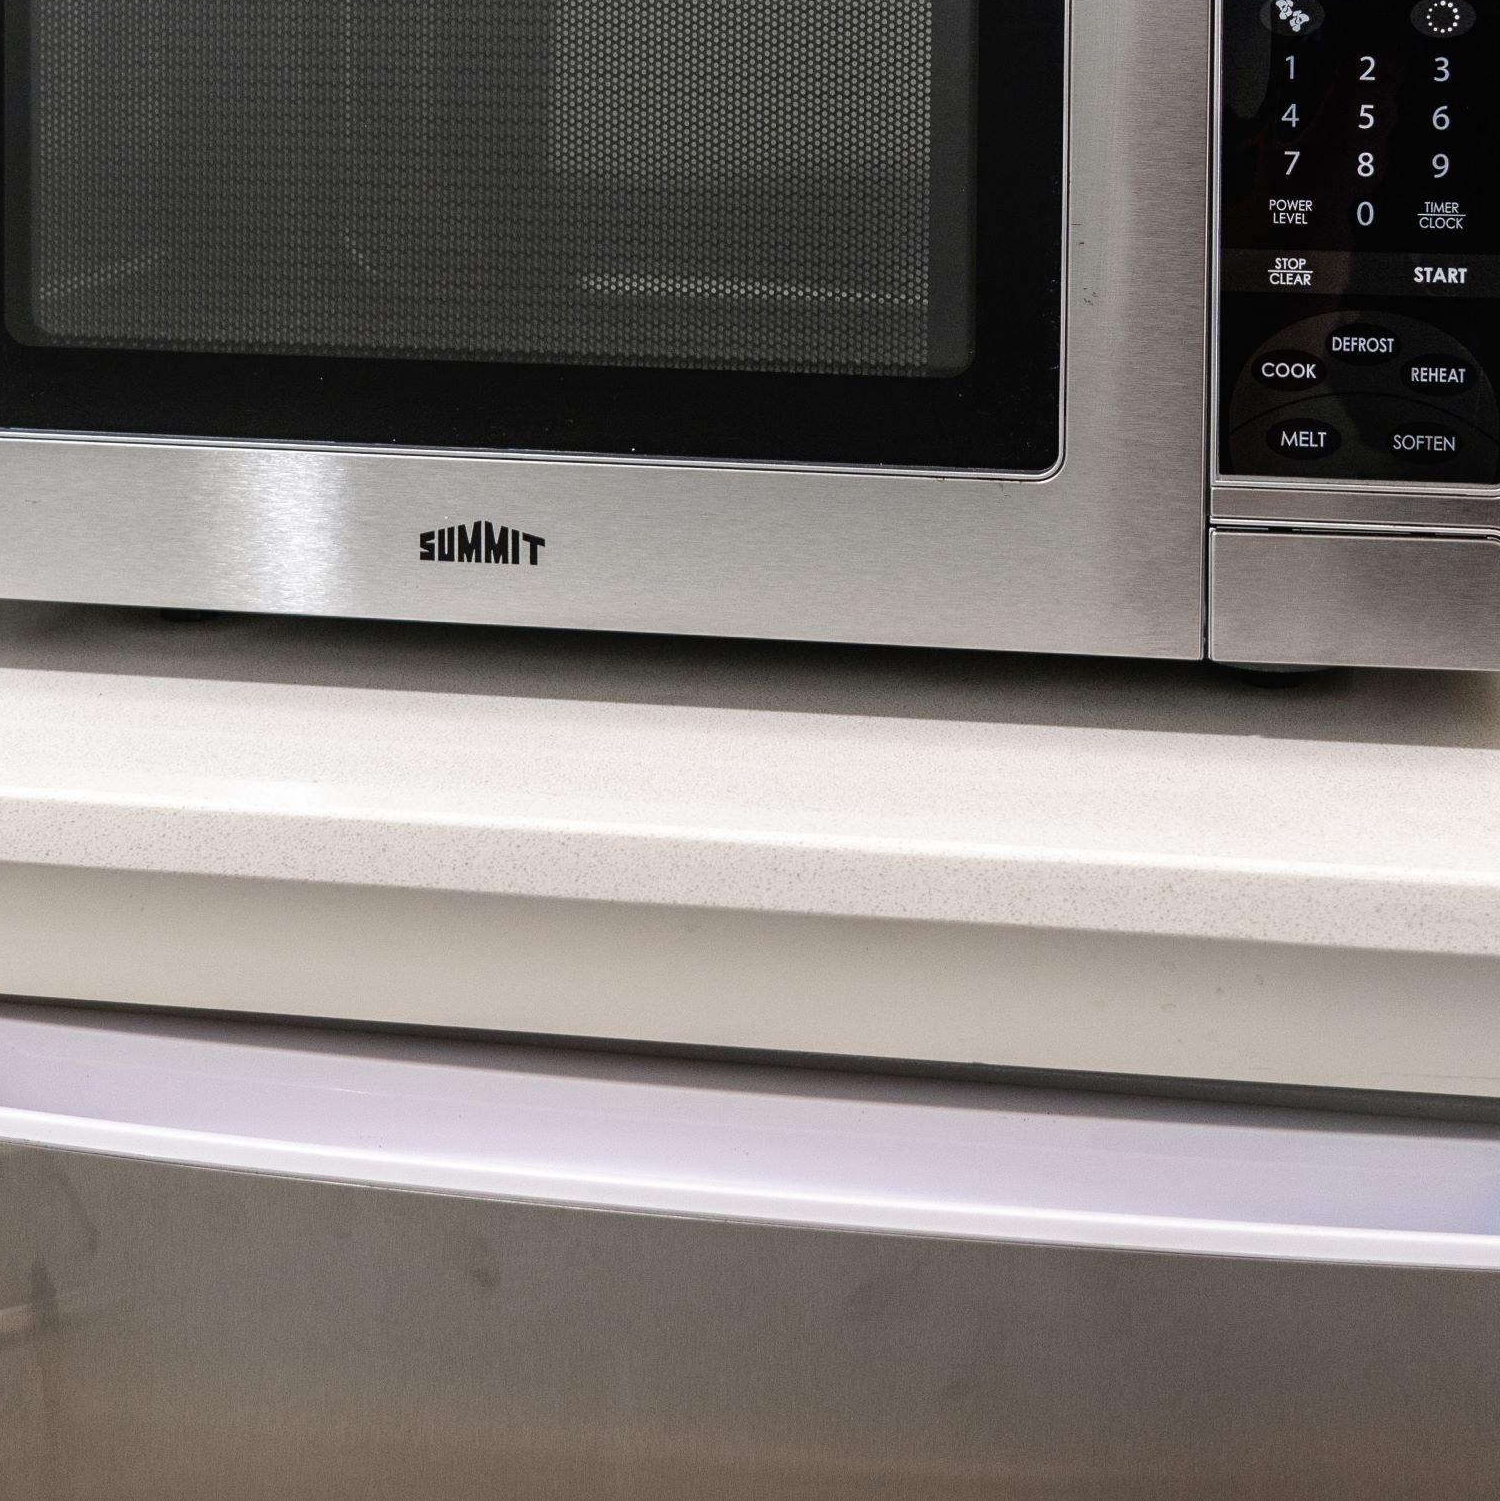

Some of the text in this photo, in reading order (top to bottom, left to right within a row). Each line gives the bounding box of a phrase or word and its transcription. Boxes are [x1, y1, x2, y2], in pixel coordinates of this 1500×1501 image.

[1285, 55, 1296, 80] 1
[1359, 55, 1376, 81] 2
[1433, 56, 1450, 82] 3
[1281, 103, 1300, 128] 4
[1358, 104, 1375, 130] 5
[1432, 105, 1450, 131] 6
[1284, 150, 1301, 176] 7
[1357, 152, 1375, 178] 8
[1431, 153, 1450, 179] 9
[1269, 199, 1313, 212] POWER
[1356, 201, 1375, 227] 0
[1424, 201, 1460, 214] TIMER
[1273, 212, 1308, 225] LEVEL
[1419, 215, 1463, 230] CLOCK
[1274, 257, 1307, 270] STOP
[1269, 271, 1312, 286] CLEAR
[1413, 266, 1468, 284] START
[1332, 336, 1395, 353] DEFROST
[1261, 362, 1317, 379] COOK
[1411, 367, 1466, 384] REHEAT
[1280, 430, 1327, 448] MELT
[1392, 434, 1456, 453] SOFTEN
[420, 520, 545, 565] SUMMIT
